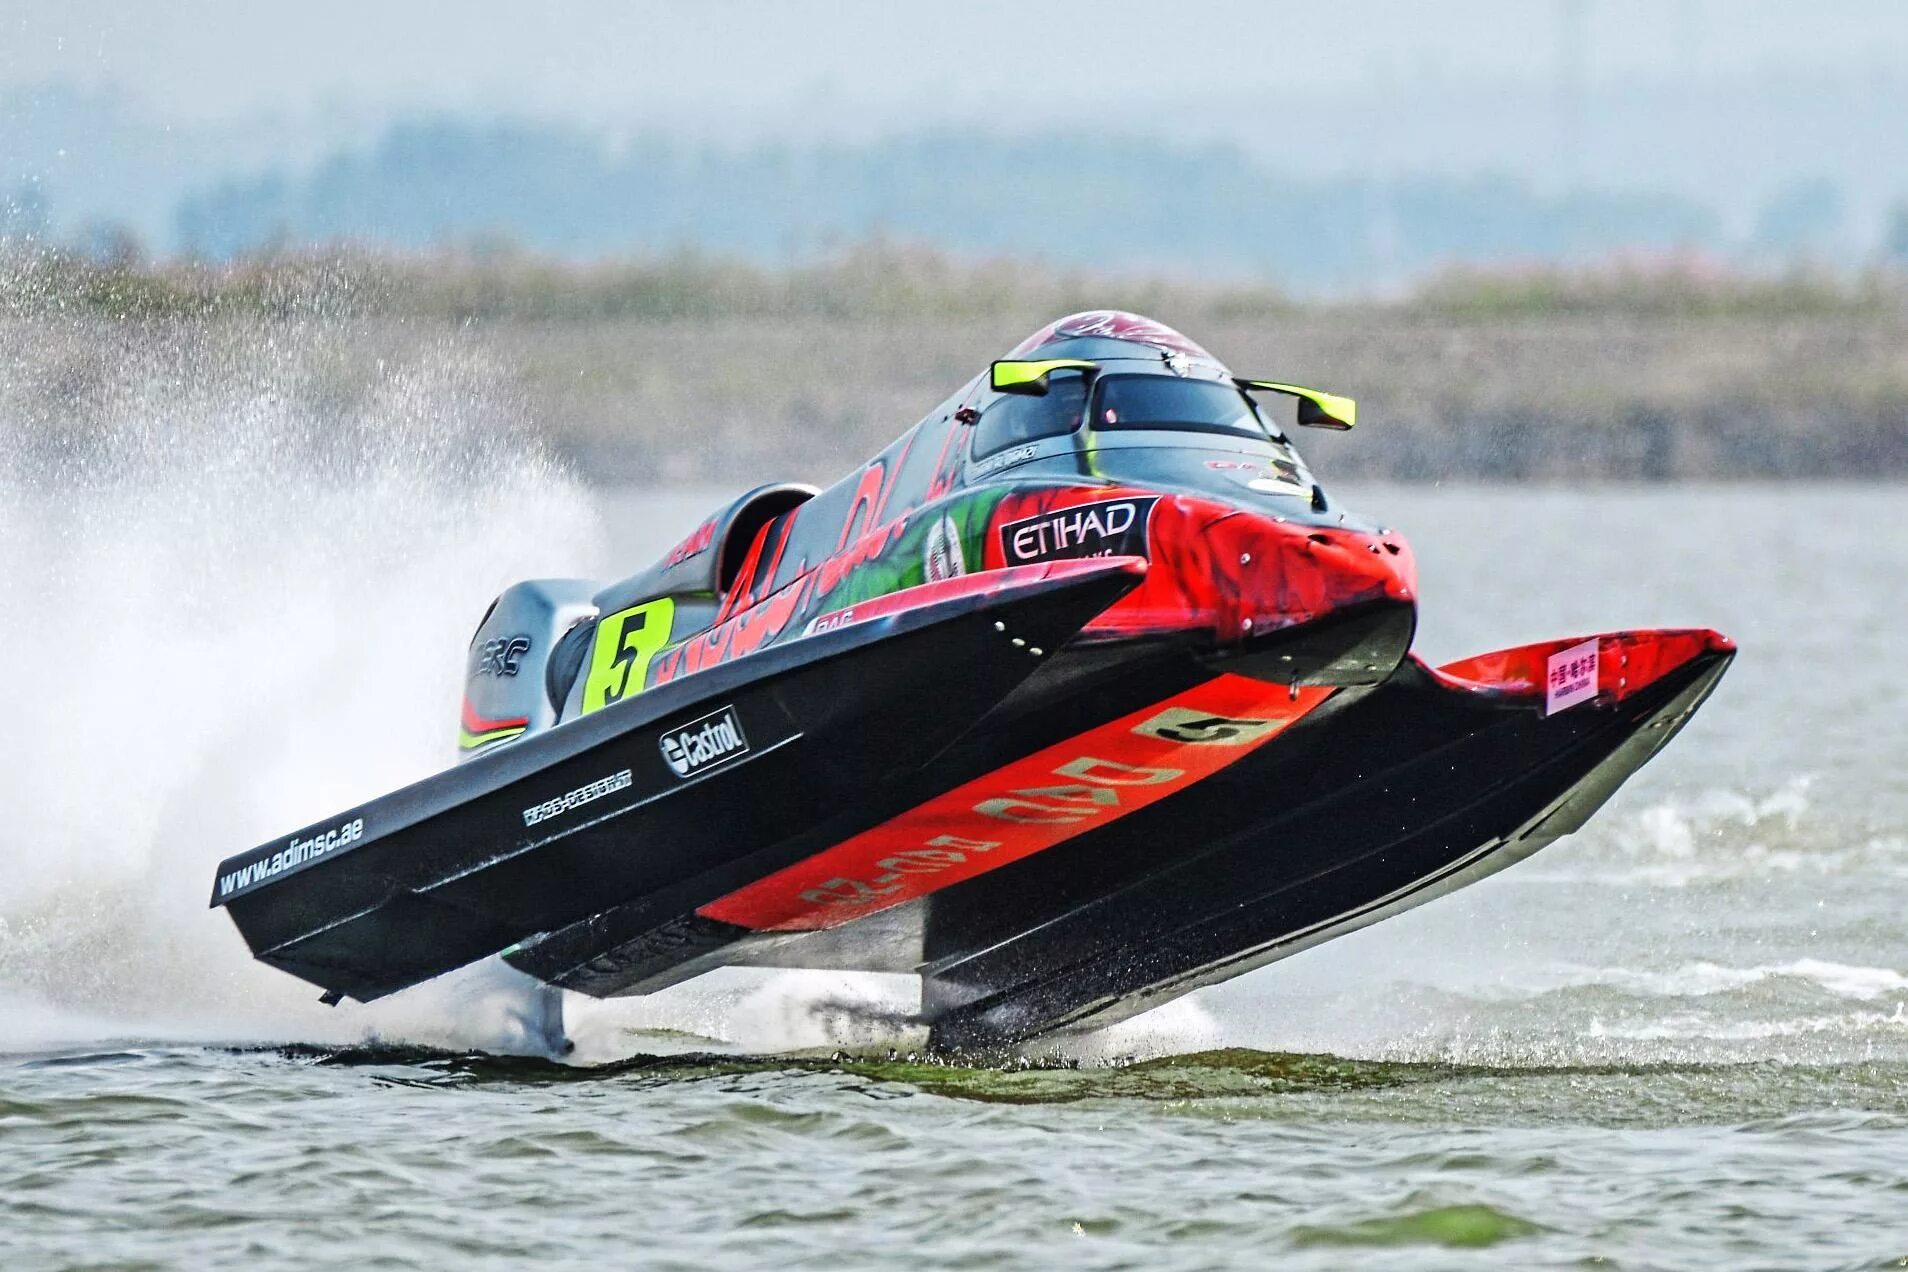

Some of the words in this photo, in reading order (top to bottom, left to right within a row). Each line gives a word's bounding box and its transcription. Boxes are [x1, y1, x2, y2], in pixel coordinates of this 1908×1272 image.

[1013, 502, 1136, 560] ETIHAD
[603, 610, 648, 706] 5
[680, 713, 743, 768] Castrol
[1156, 716, 1267, 743] 5
[219, 817, 364, 897] www.adimsc.ae
